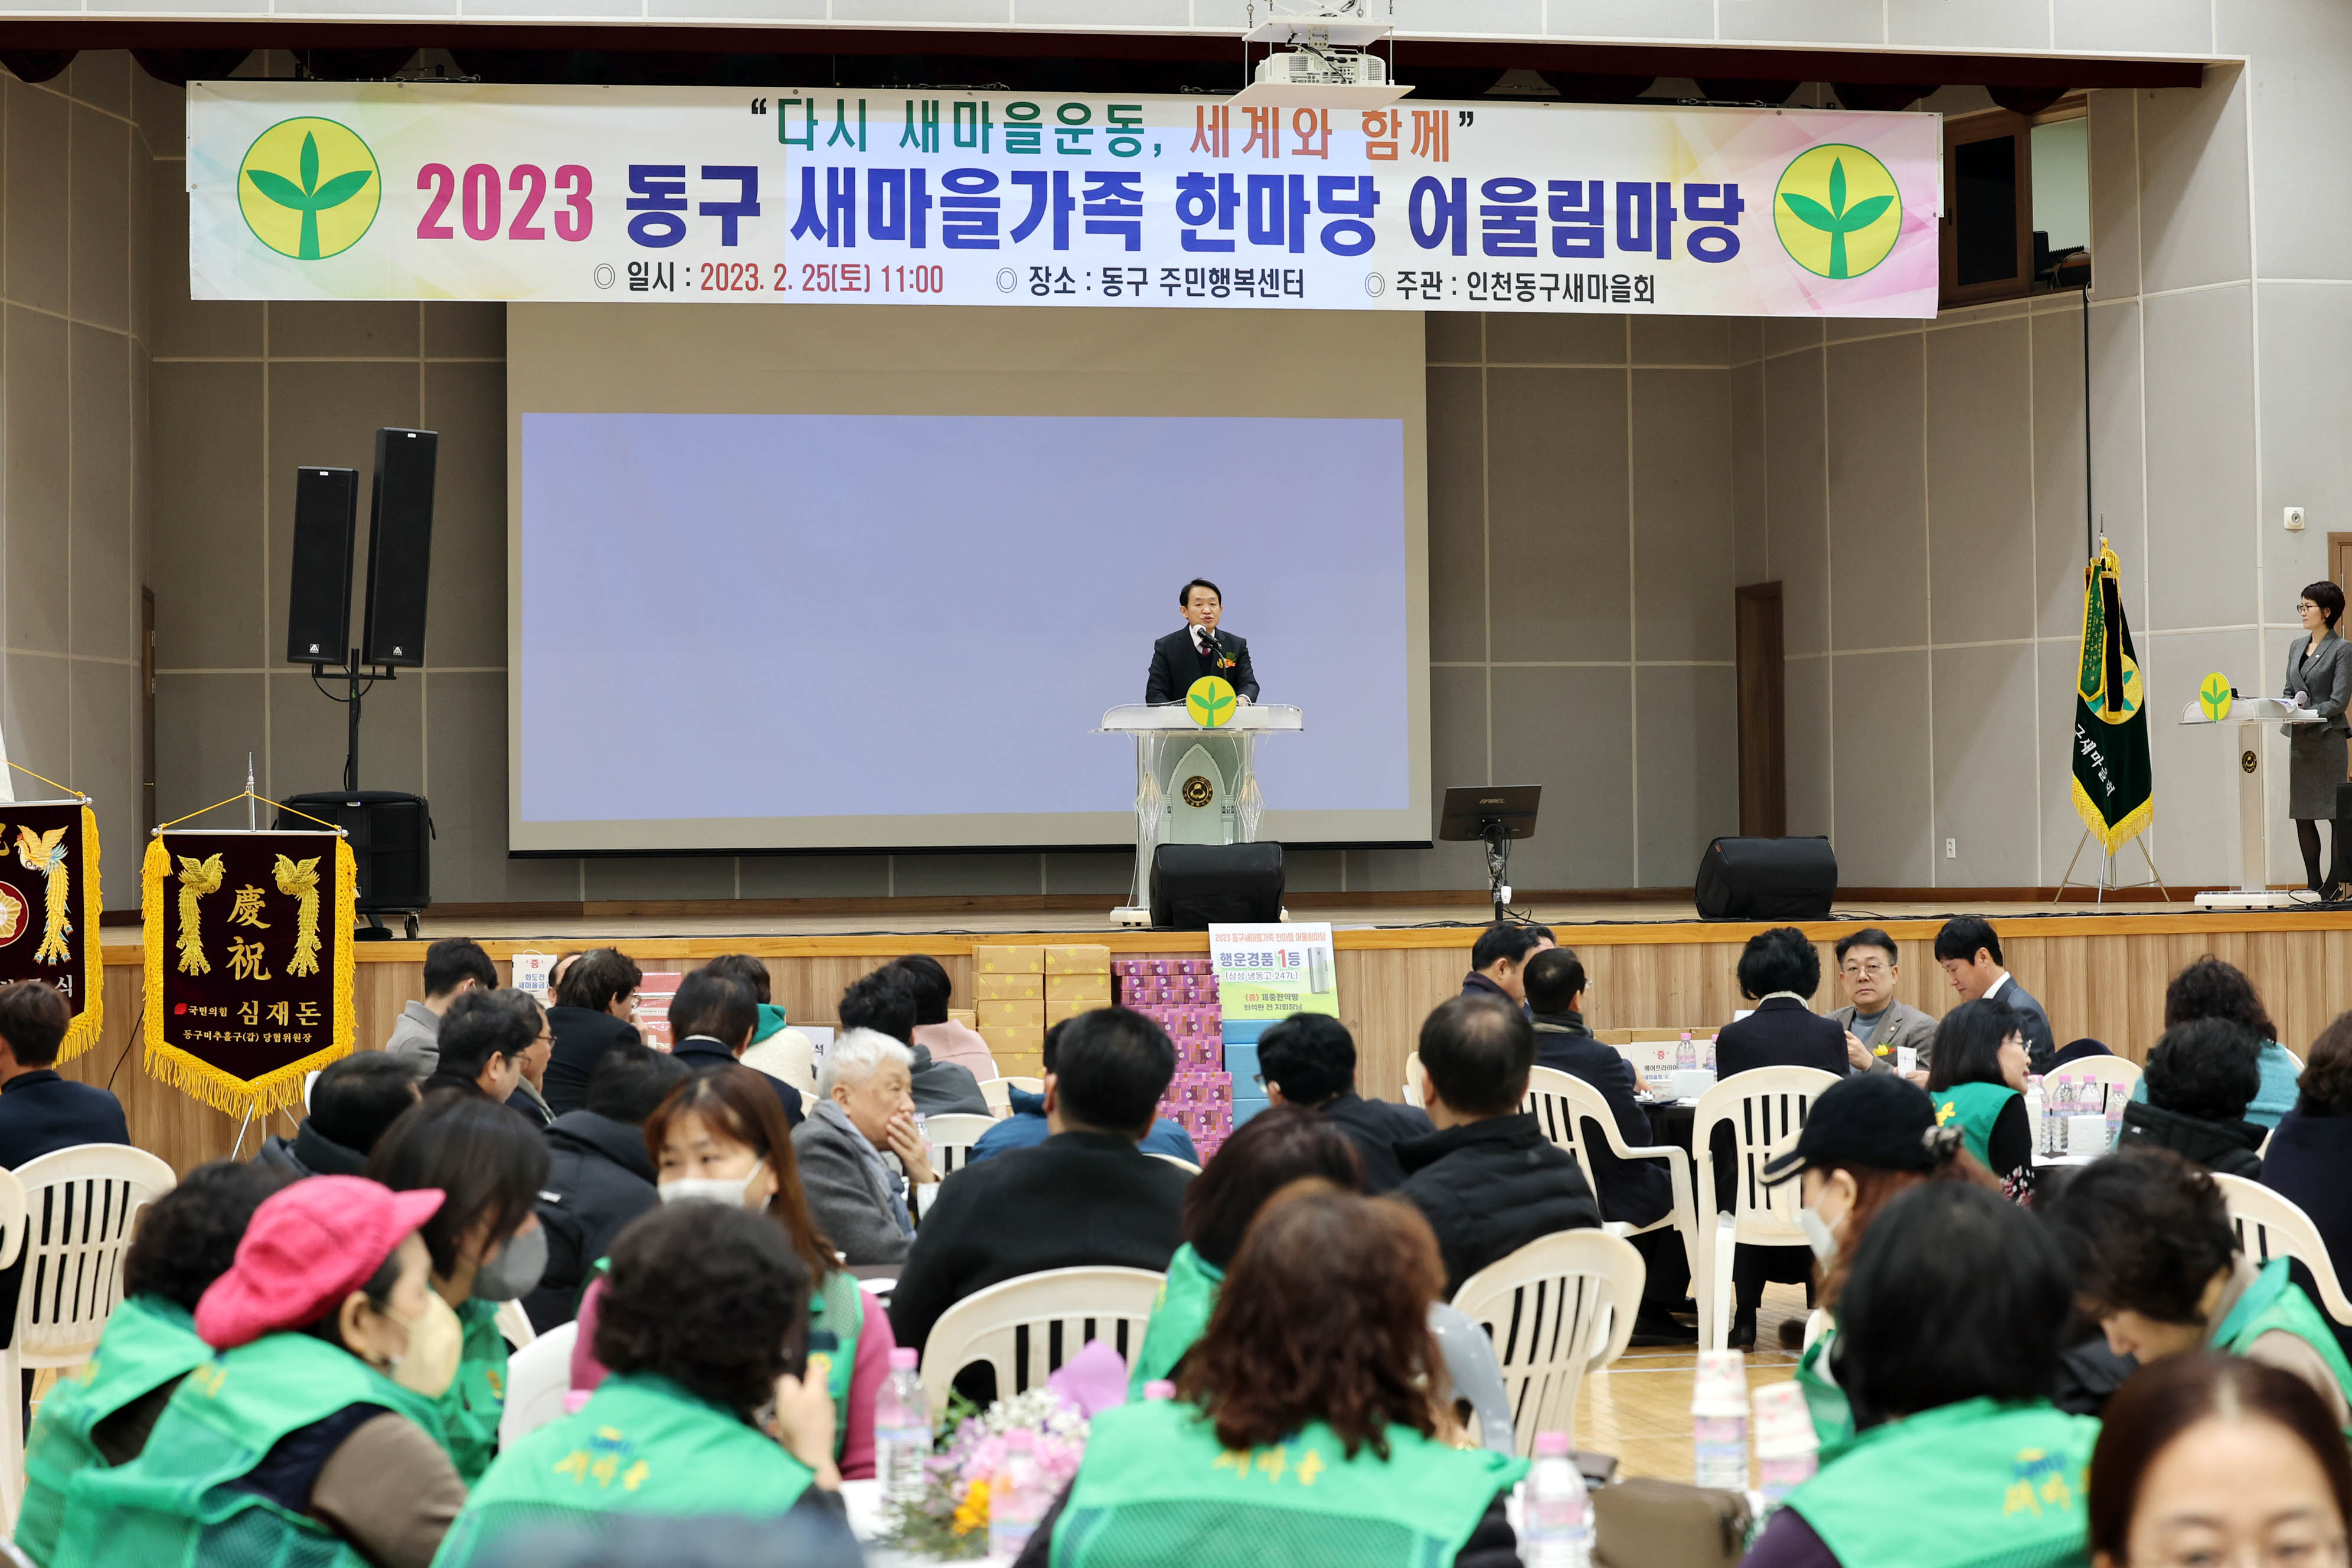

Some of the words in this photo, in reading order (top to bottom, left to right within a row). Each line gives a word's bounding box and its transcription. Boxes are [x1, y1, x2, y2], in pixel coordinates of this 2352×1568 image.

[899, 100, 1162, 158] 새마을운동,
[1190, 104, 1332, 159] 세계와
[417, 164, 593, 242] 2023
[626, 165, 760, 249] 동구
[790, 166, 1144, 251] 새마을가족
[1176, 172, 1380, 257] 한마당
[1409, 175, 1745, 263] 어울림마당
[701, 262, 765, 292] 2023.
[802, 264, 871, 294] 25(토)
[881, 264, 943, 293] 11:00
[1102, 267, 1148, 297] 동구
[1160, 267, 1304, 298] 주민행복센터
[1467, 272, 1655, 304] 인천동구새마을회
[1215, 934, 1230, 942] 2023
[1220, 952, 1273, 967] 행운경품
[1226, 972, 1245, 981] (삼성
[1247, 972, 1272, 981] 냉동고
[188, 1005, 227, 1017] 국민의힘
[183, 1030, 259, 1043] 동구미추홀구(갑)
[263, 1033, 312, 1043] 당협위원장
